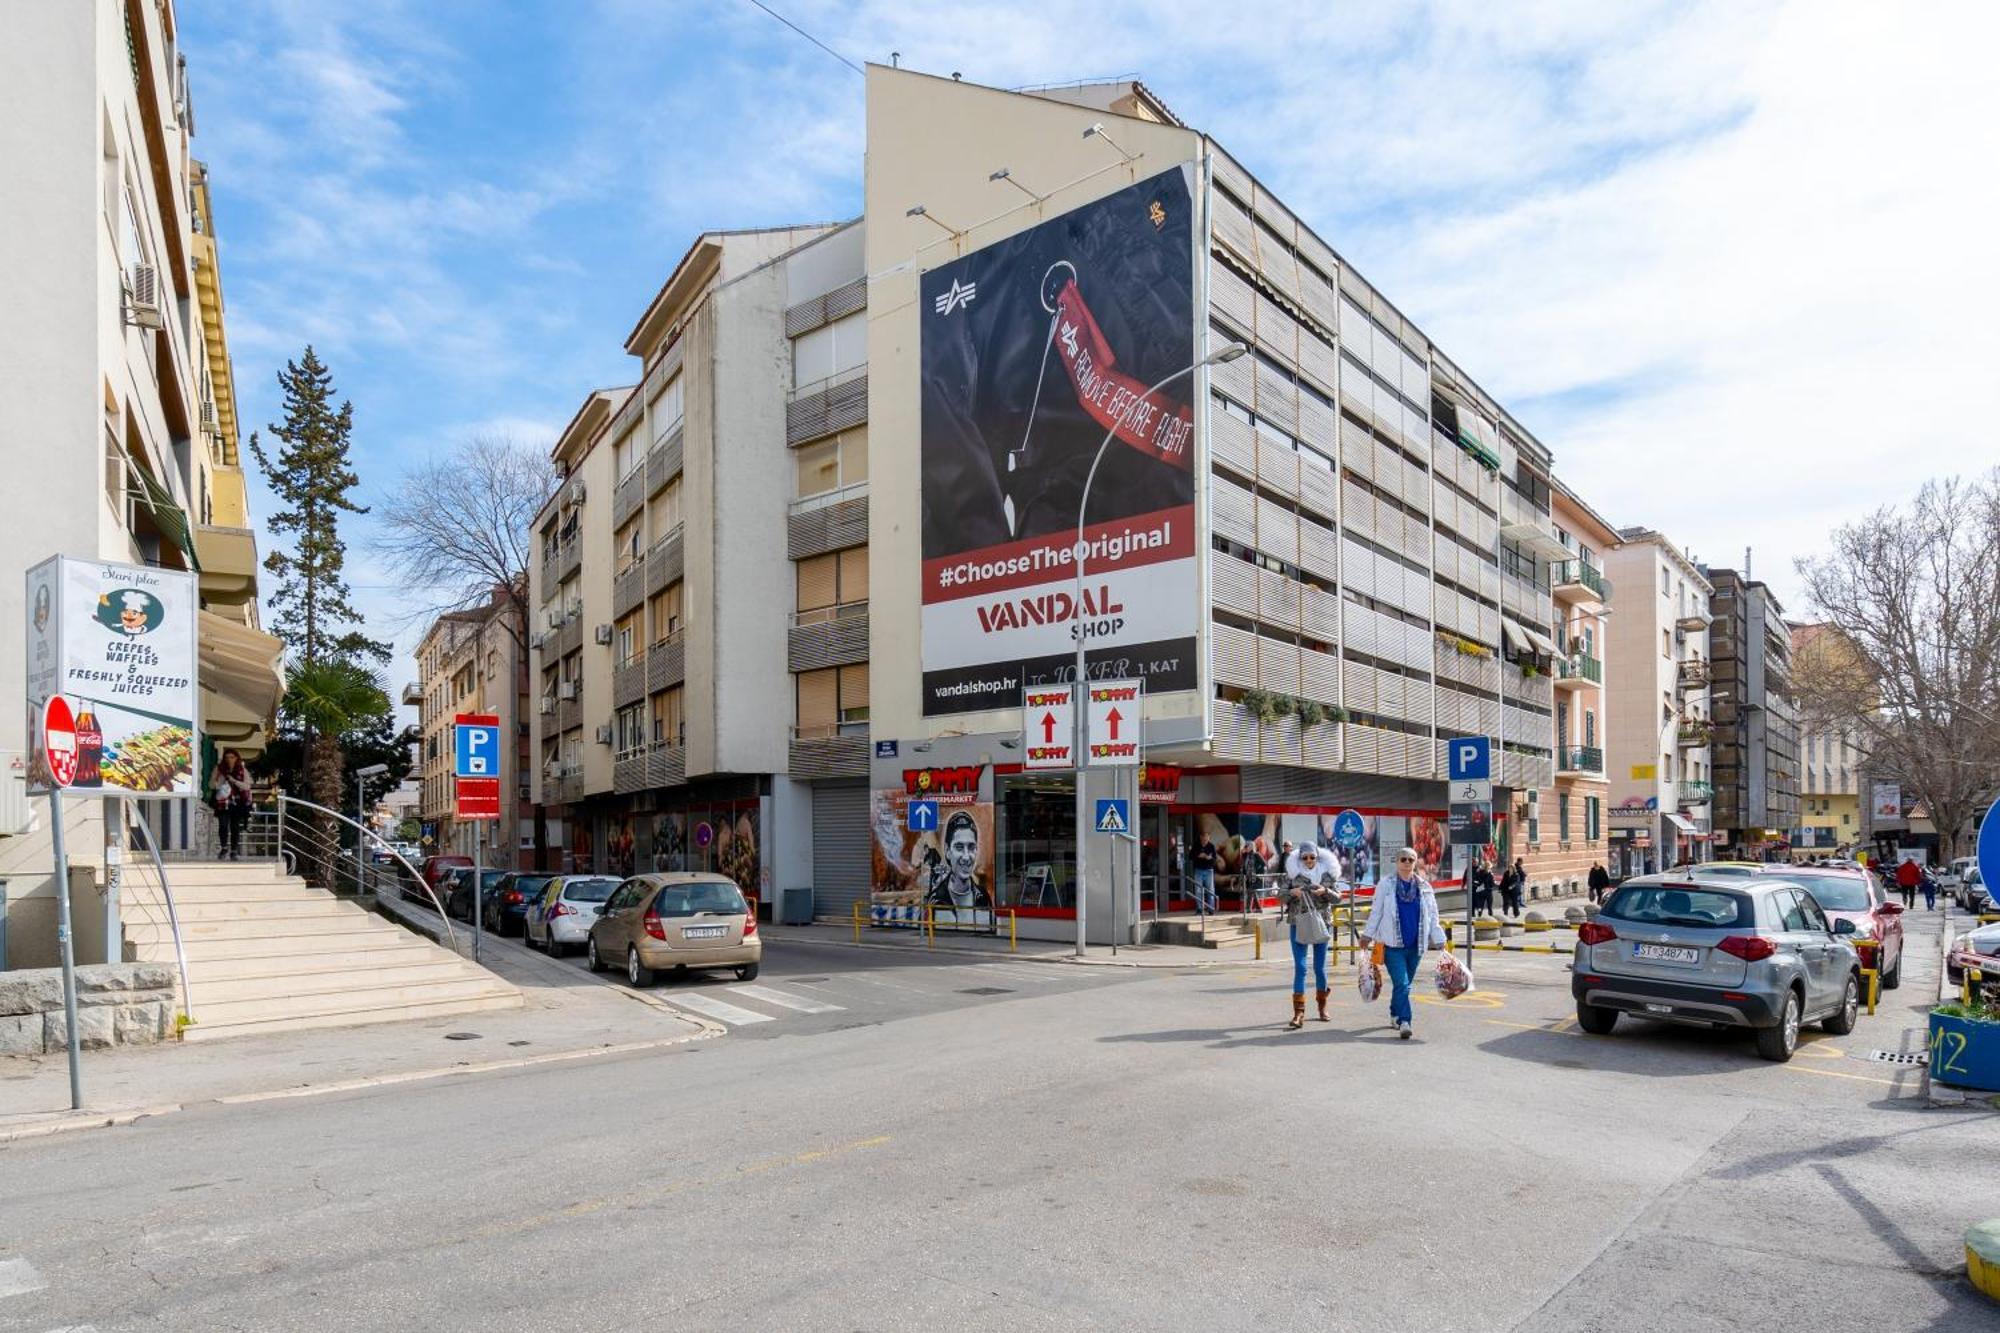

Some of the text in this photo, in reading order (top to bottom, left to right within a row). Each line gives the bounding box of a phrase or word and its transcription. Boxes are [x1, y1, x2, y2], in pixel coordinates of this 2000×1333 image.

[1074, 347, 1115, 408] REMOVE
[1106, 386, 1158, 438] BEFORE
[939, 521, 1171, 588] #ChooseTheOriginal
[977, 585, 1124, 633] VANDAL
[1070, 618, 1124, 641] SHOP
[105, 652, 159, 666] WAFFLES
[127, 664, 137, 674] &
[1150, 658, 1180, 674] KAT
[69, 668, 123, 682] FRESHLY
[127, 674, 189, 689] SQUEEZED
[111, 683, 153, 696] JUICES
[935, 677, 1017, 698] vandalshop.hr
[468, 728, 489, 755] P
[1460, 745, 1478, 773] P
[902, 765, 986, 796] TOMMY
